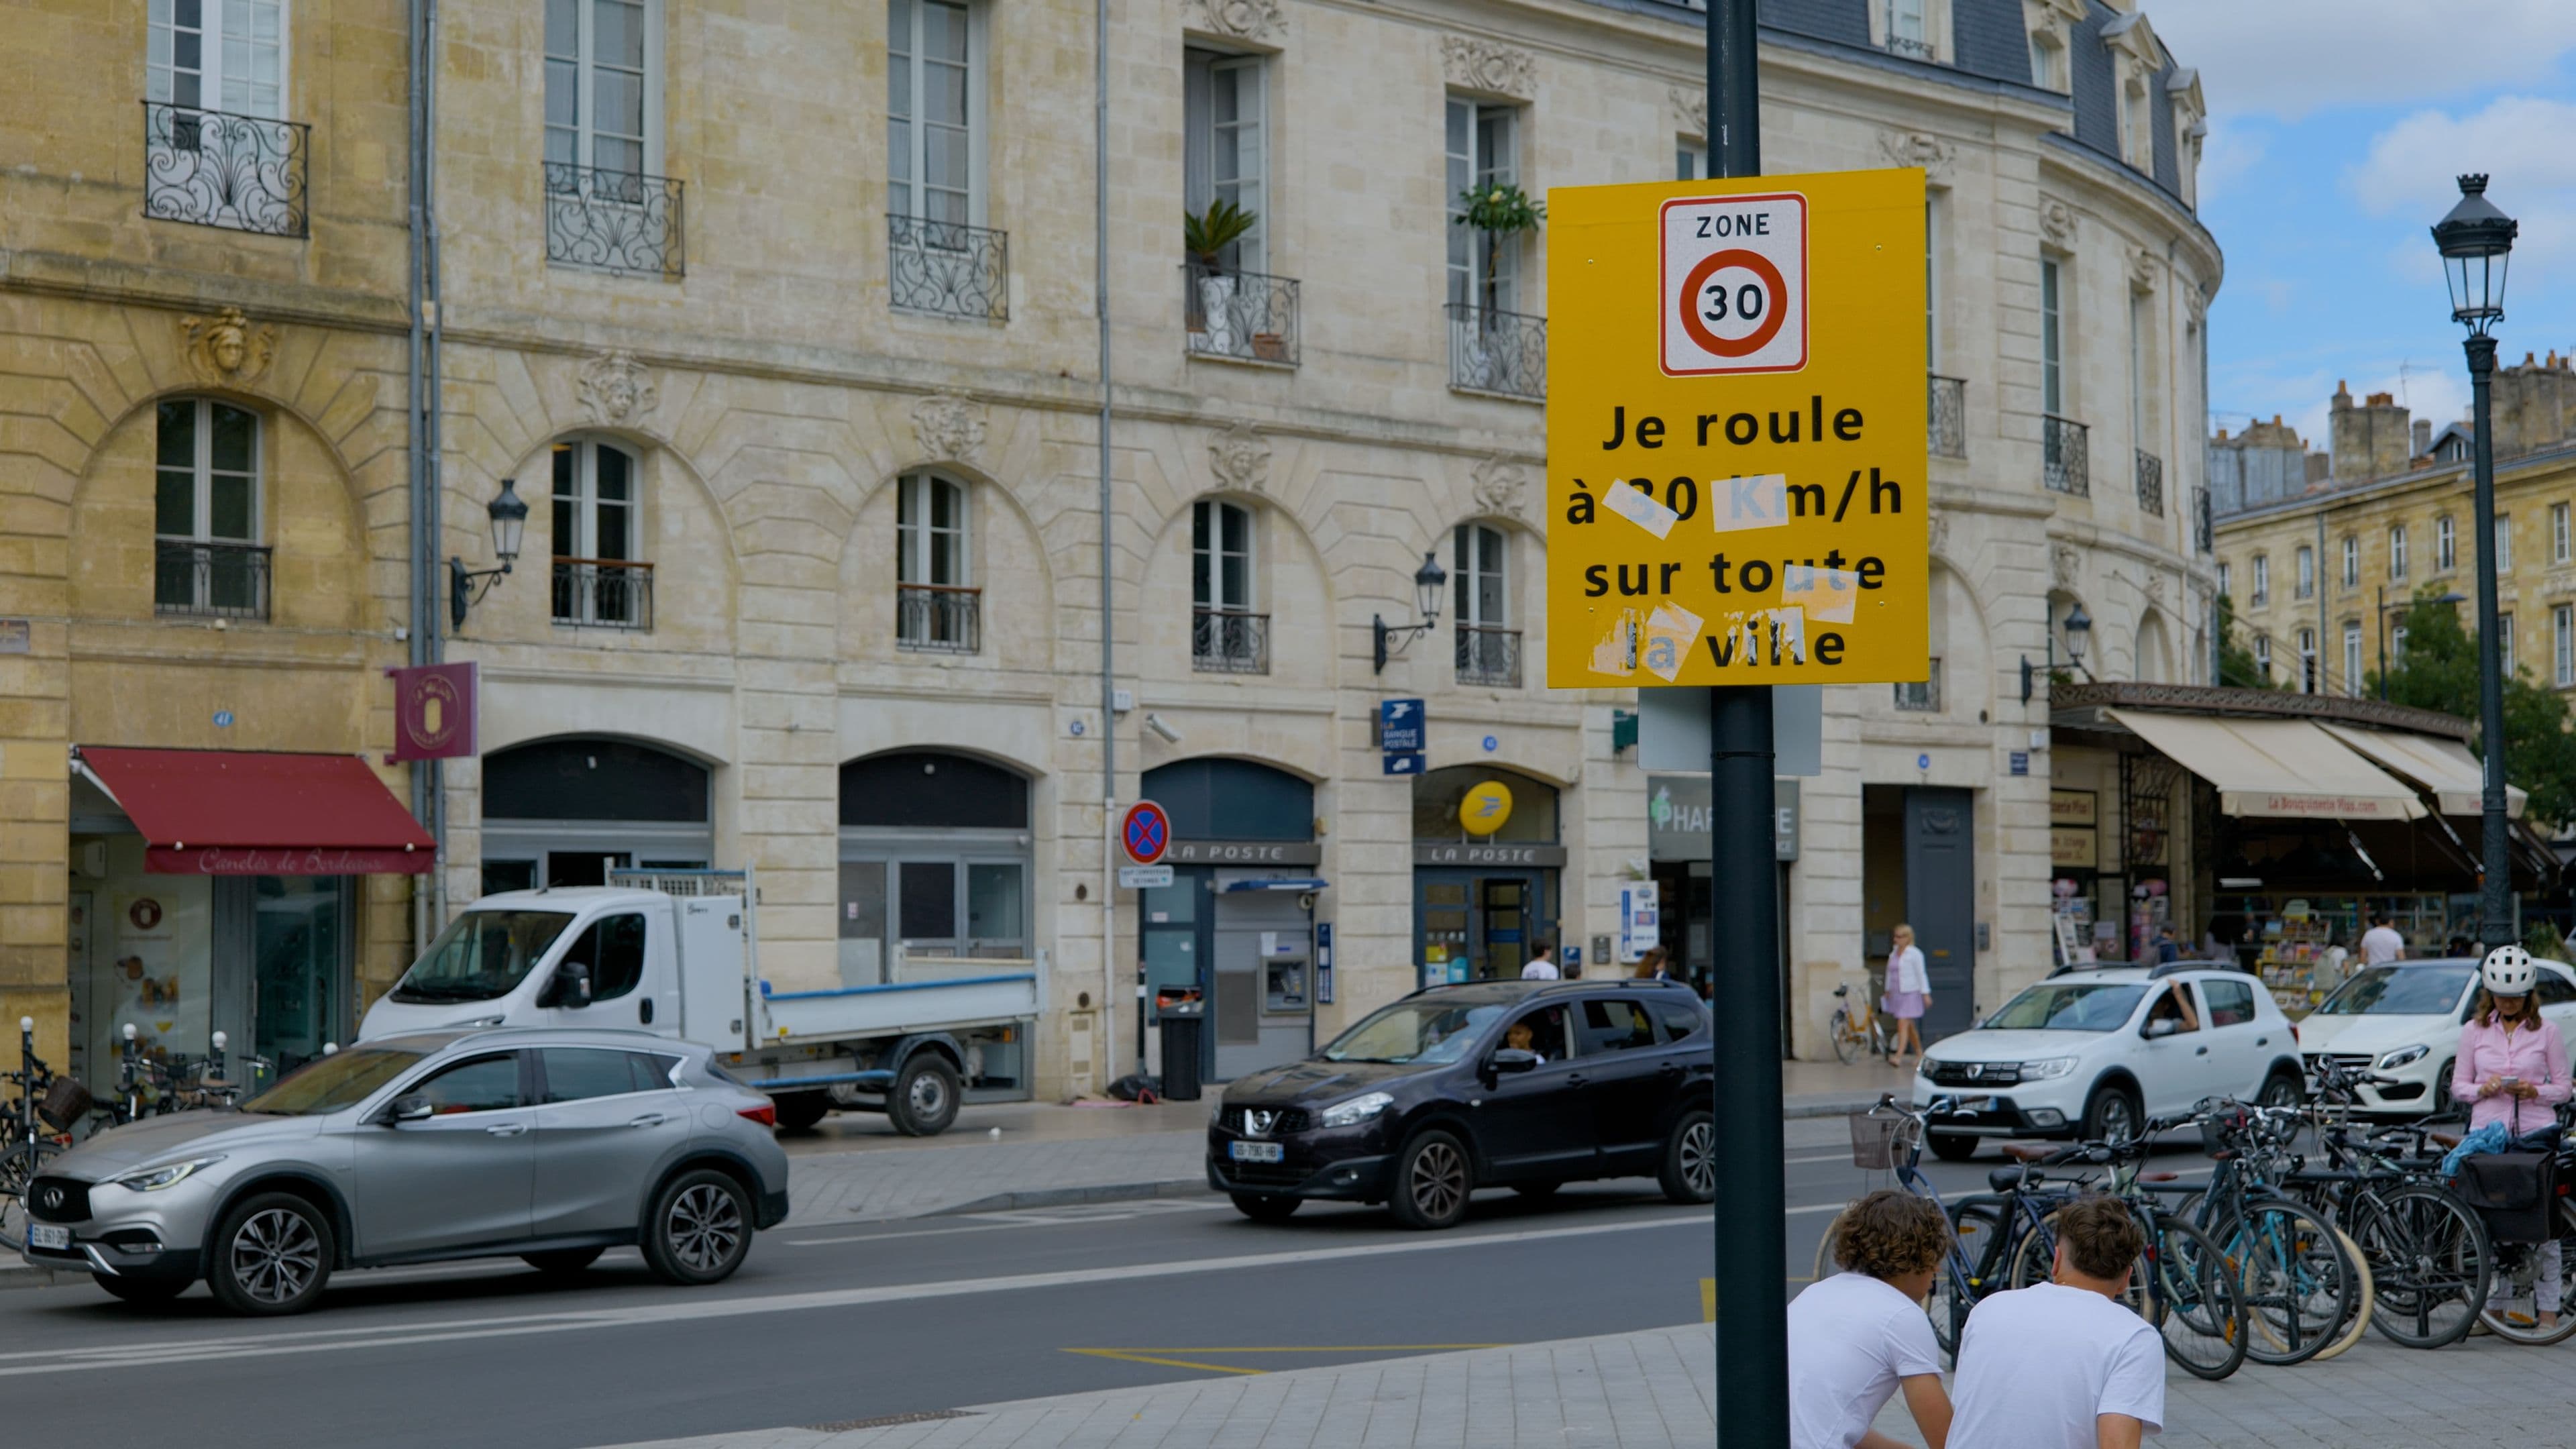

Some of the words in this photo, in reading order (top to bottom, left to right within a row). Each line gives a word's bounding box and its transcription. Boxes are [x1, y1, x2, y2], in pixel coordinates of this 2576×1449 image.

[1697, 213, 1770, 238] ZONE
[1704, 284, 1764, 321] 30
[1603, 407, 1666, 450] Je
[1697, 396, 1864, 446] roule
[1567, 479, 1595, 524] à
[1627, 476, 1698, 523] 30
[1731, 468, 1902, 523] Km/h
[1585, 562, 1680, 598] sur
[1710, 549, 1885, 593] toute
[1627, 619, 1676, 669] la
[1706, 616, 1845, 667] ville
[1383, 729, 1417, 739] BANQUE
[1383, 739, 1417, 749] POSTALE
[276, 850, 296, 871] de
[1167, 845, 1195, 859] LA
[1209, 845, 1283, 860] POSTE
[1432, 848, 1457, 861] LA
[1468, 848, 1535, 863] POSTE
